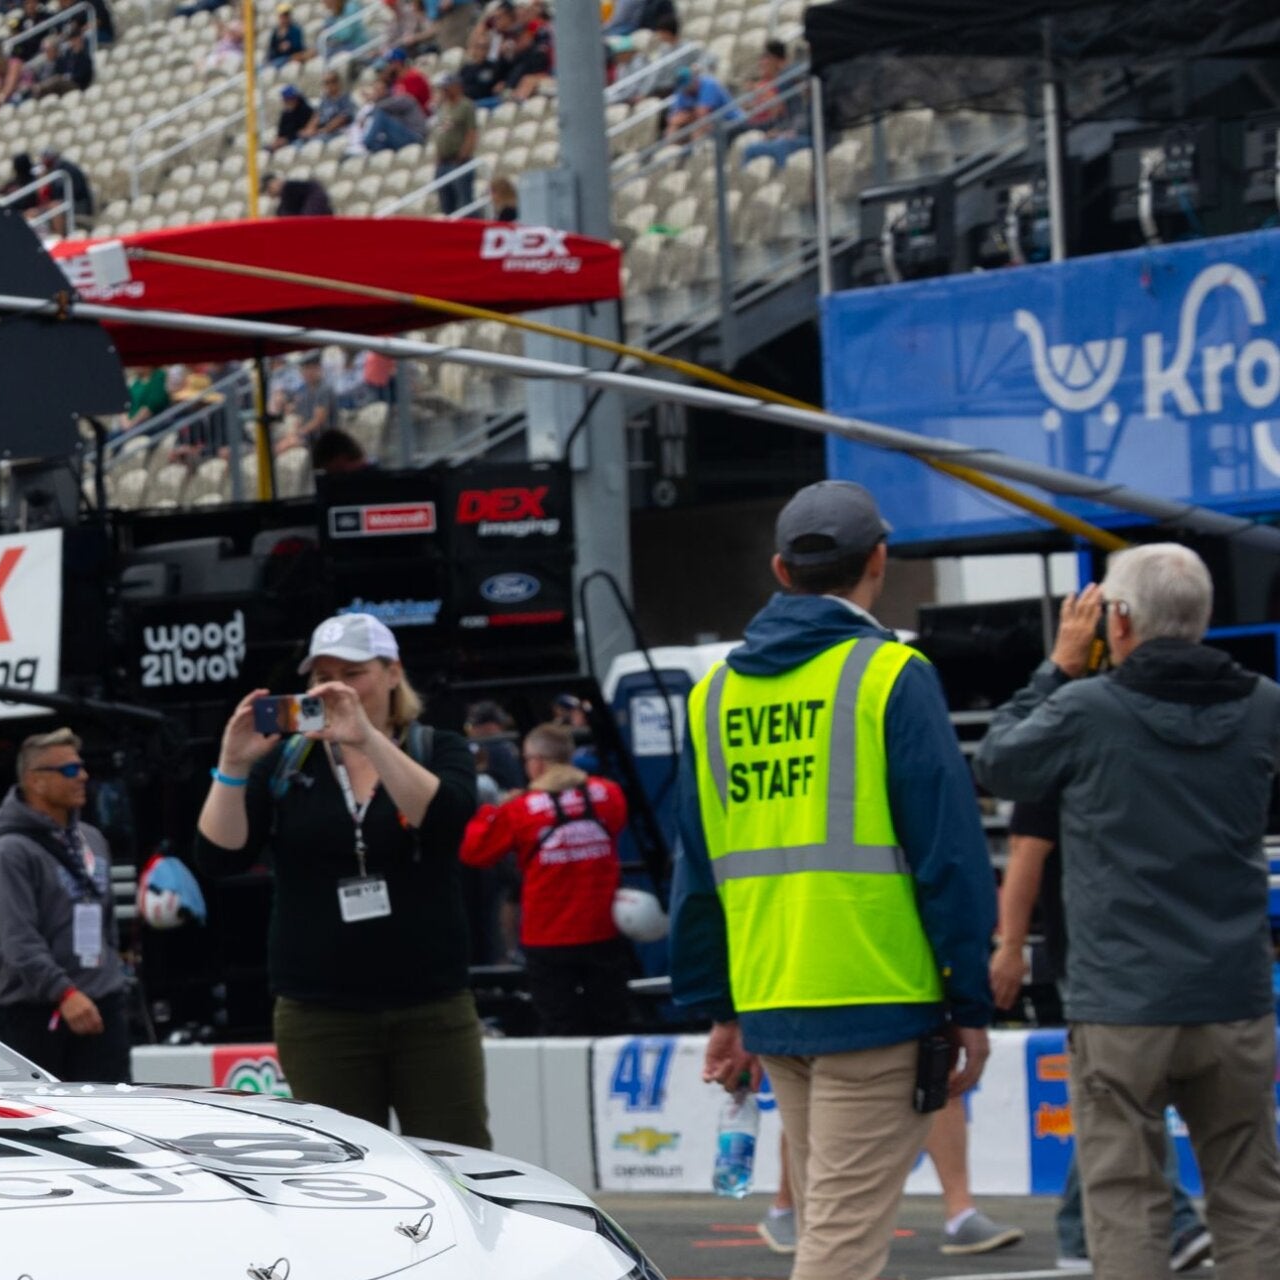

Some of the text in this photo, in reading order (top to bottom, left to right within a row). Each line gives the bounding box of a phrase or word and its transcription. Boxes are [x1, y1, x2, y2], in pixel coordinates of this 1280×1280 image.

[480, 226, 570, 259] DEX
[1143, 262, 1280, 478] Kro
[456, 485, 549, 524] DEX
[477, 518, 560, 537] imaging
[144, 609, 246, 652] wood
[726, 699, 826, 748] EVENT
[730, 755, 815, 803] STAFF
[610, 1036, 676, 1113] 47
